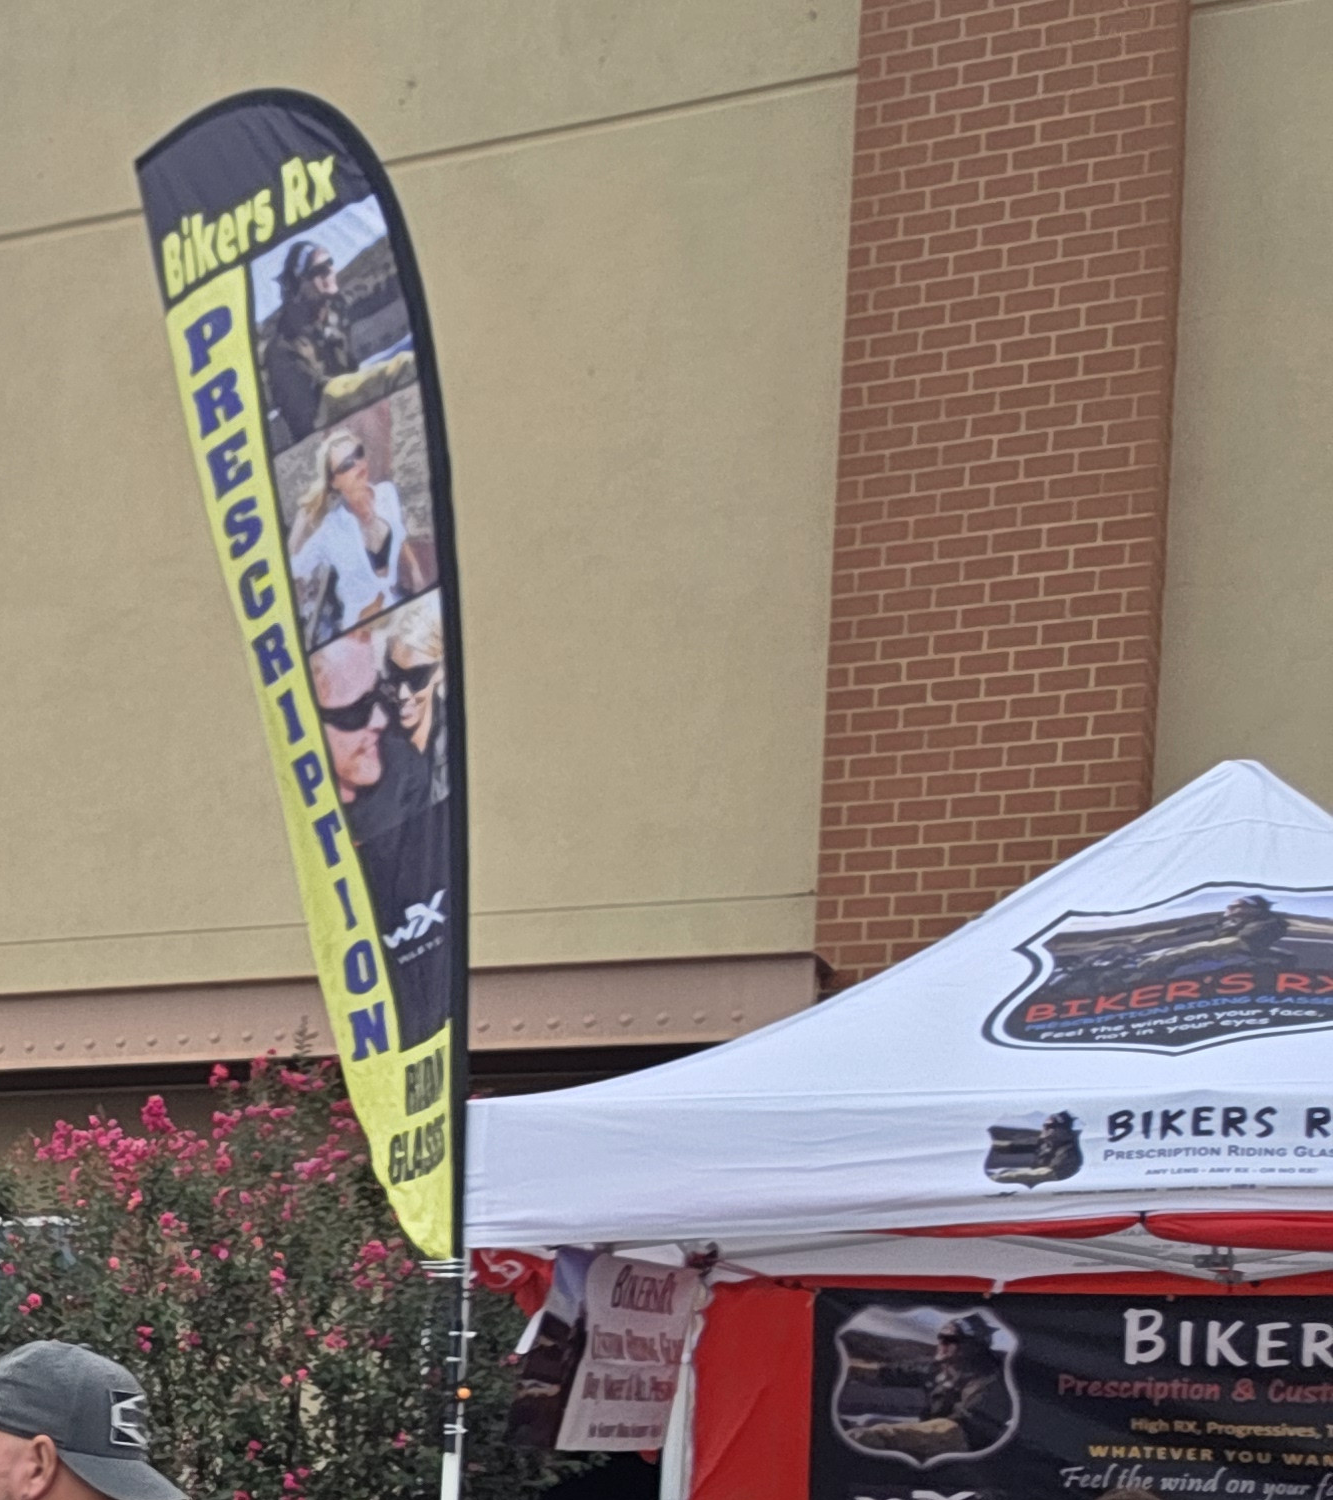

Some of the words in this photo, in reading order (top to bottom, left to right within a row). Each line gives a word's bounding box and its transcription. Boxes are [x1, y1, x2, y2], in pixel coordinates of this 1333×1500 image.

[162, 188, 275, 299] Bikers
[280, 155, 337, 227] Rx
[183, 304, 391, 1062] PRESCRIPTION
[1024, 973, 1256, 1024] BIKER'S
[1040, 1028, 1084, 1040] Feel
[1090, 1024, 1126, 1034] the
[1130, 1016, 1179, 1028] wind
[1183, 1012, 1209, 1022] on
[1214, 1009, 1263, 1020] your
[1095, 1031, 1130, 1040] not
[1135, 1028, 1155, 1036] in
[1166, 1020, 1215, 1034] your
[1219, 1018, 1271, 1027] eyes
[1106, 1105, 1278, 1143] BIKERS
[1123, 1307, 1333, 1369] BIKER
[1057, 1373, 1221, 1406] Prescription
[1232, 1378, 1256, 1402] &
[1130, 1418, 1170, 1434] High
[1206, 1421, 1322, 1439] Progressives,
[1088, 1445, 1214, 1462] WHATEVER
[1224, 1450, 1272, 1464] YOU
[1059, 1463, 1118, 1489] Feel
[1116, 1463, 1153, 1491] the
[1160, 1467, 1228, 1494] wind
[1225, 1480, 1256, 1494] on
